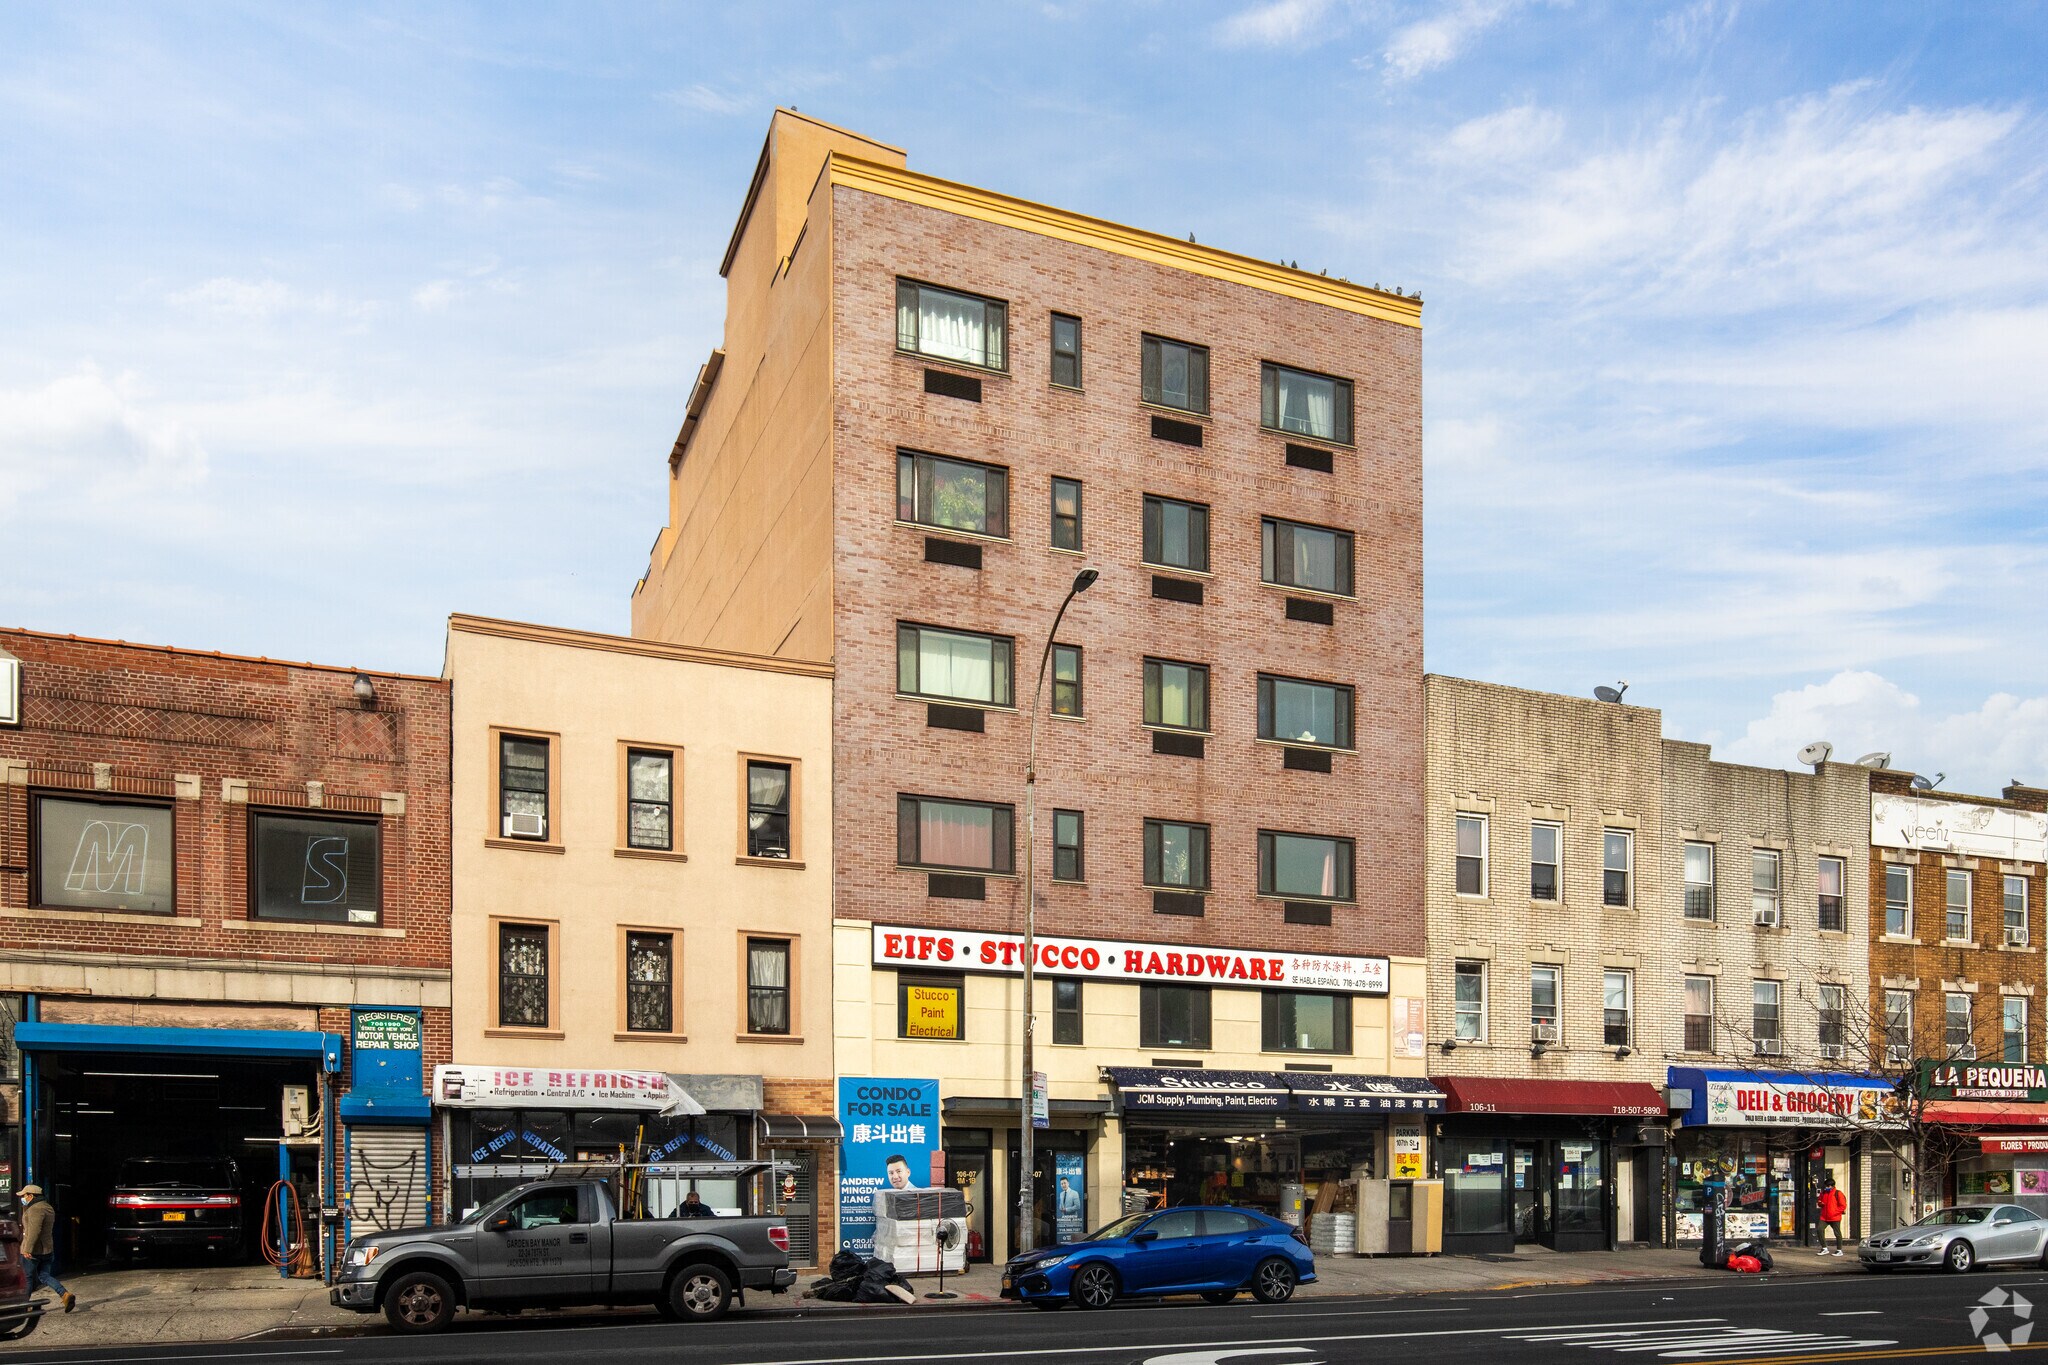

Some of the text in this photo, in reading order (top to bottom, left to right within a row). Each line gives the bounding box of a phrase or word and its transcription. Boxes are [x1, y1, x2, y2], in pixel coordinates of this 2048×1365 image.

[883, 933, 1285, 982] EIFS STUCCO HARDWARE
[1292, 976, 1298, 984] SE
[1299, 976, 1316, 985] HABLA
[1343, 979, 1383, 989] 718-478-8999
[914, 988, 949, 1001] Stucco
[357, 1011, 416, 1026] REGISTERED
[921, 1007, 945, 1018] Paint
[357, 1031, 418, 1041] MOTOR VEHICLE
[909, 1024, 954, 1037] Electrical
[356, 1040, 420, 1050] REPAIR SHOP
[494, 1071, 534, 1087] ICE
[1160, 1076, 1266, 1089] Stucco
[1934, 1065, 2047, 1088] LA PEQUEÑA
[494, 1087, 538, 1097] Refrigeration
[546, 1089, 571, 1098] Central
[572, 1089, 585, 1098] A/C
[598, 1090, 609, 1098] Ice
[610, 1090, 636, 1099] Machine
[856, 1086, 922, 1101] CONDO
[1959, 1089, 1993, 1097] TIENDA
[2004, 1089, 2027, 1098] DELI
[1136, 1094, 1278, 1107] JCM Supply, Plumbing, Paint, Electric
[1343, 1098, 1371, 1108] 五金
[1736, 1089, 1854, 1115] DELI & GROCERY
[847, 1102, 932, 1117] FOR SALE
[1469, 1103, 1661, 1115] 106-11 718-507-5890
[852, 1123, 926, 1144] 康斗出售
[1395, 1128, 1419, 1137] PARKING
[471, 1129, 567, 1163] ICE REFRI GERATION
[664, 1132, 690, 1154] REFRI
[695, 1133, 737, 1162] GERATION
[1396, 1139, 1409, 1147] 107th
[2000, 1141, 2023, 1151] FLORES
[956, 1170, 977, 1178] 106-07
[1684, 1164, 1688, 1172] A
[841, 1177, 885, 1186] ANDREW
[841, 1186, 879, 1195] MINGDA
[1707, 1187, 1712, 1196] P
[506, 1238, 560, 1248] GARDEN BAY MANOR
